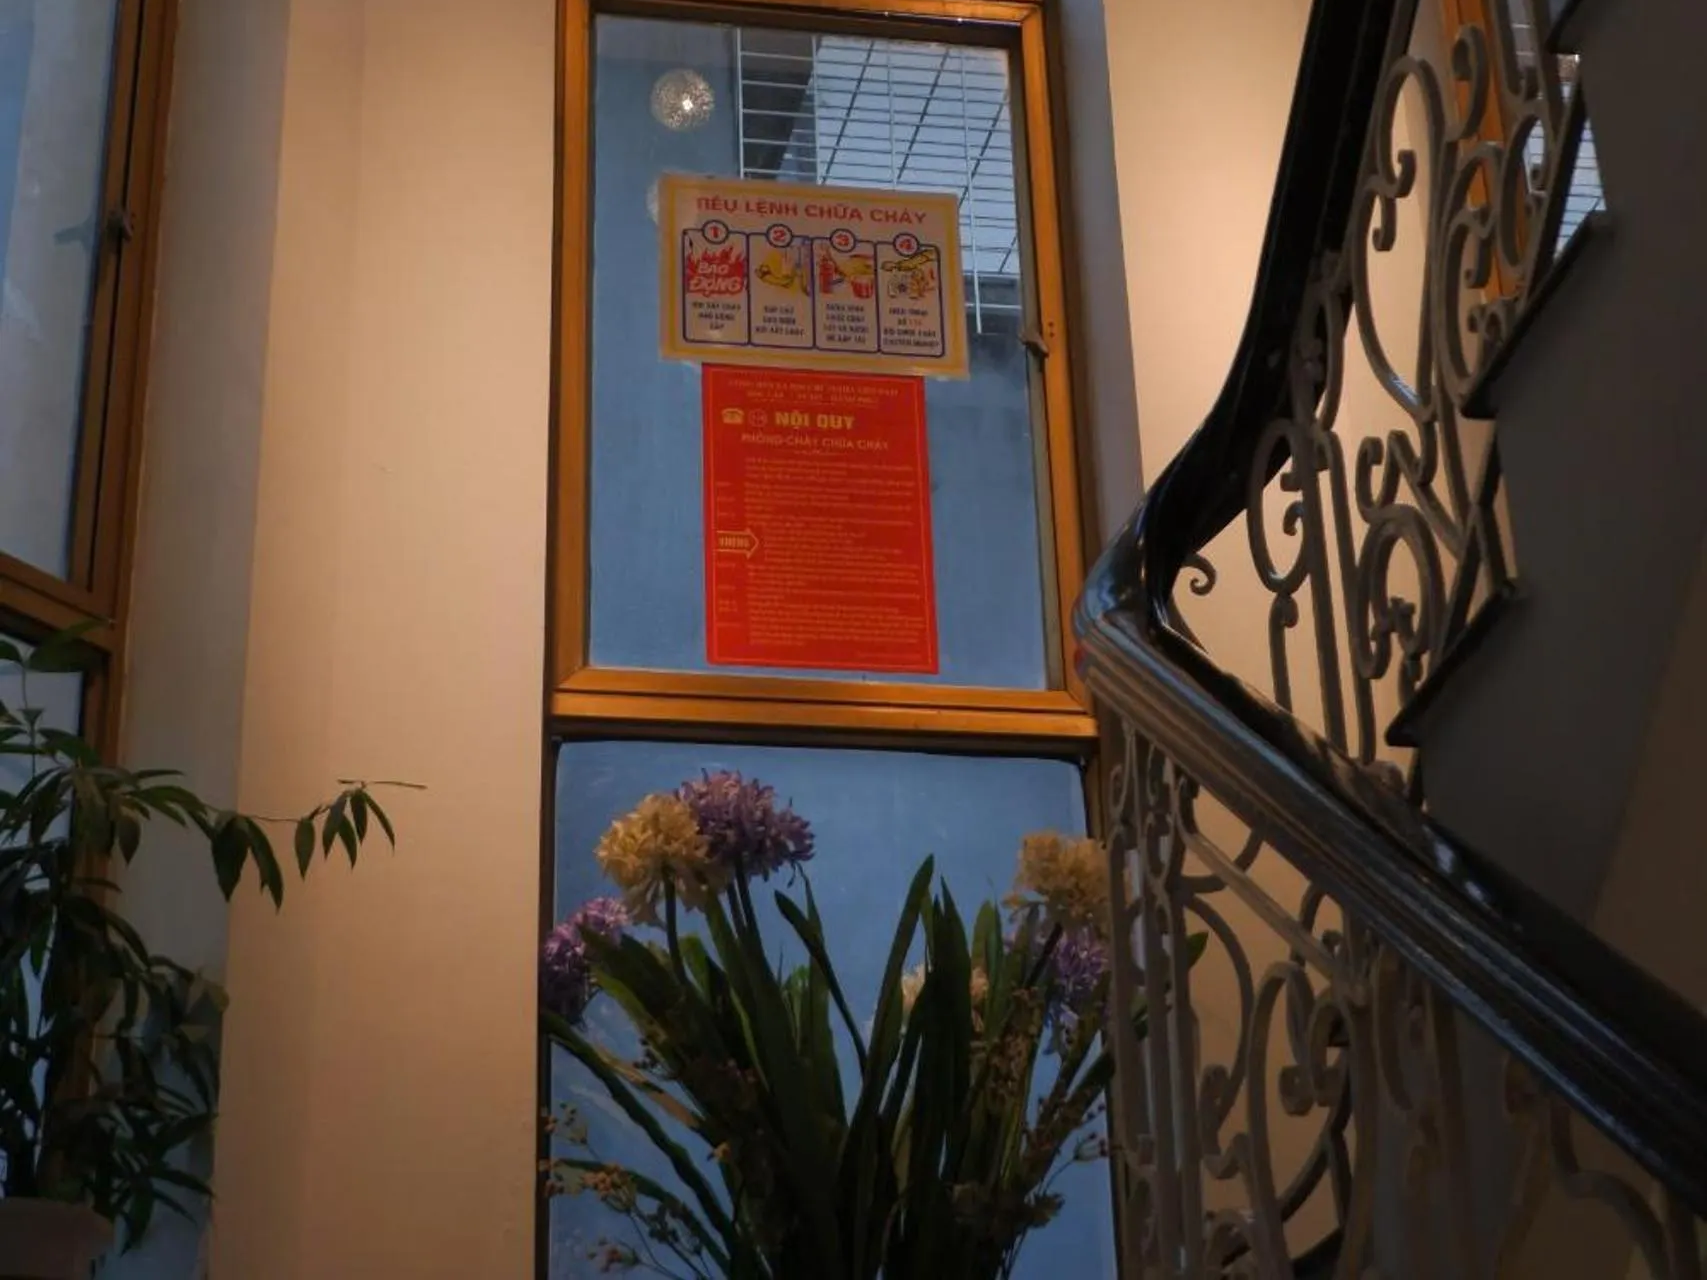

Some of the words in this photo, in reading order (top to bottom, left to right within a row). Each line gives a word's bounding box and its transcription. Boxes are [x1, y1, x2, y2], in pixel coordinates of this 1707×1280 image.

[709, 225, 719, 239] 1
[772, 229, 786, 242] 2
[835, 233, 849, 247] 3
[816, 413, 855, 431] QUY
